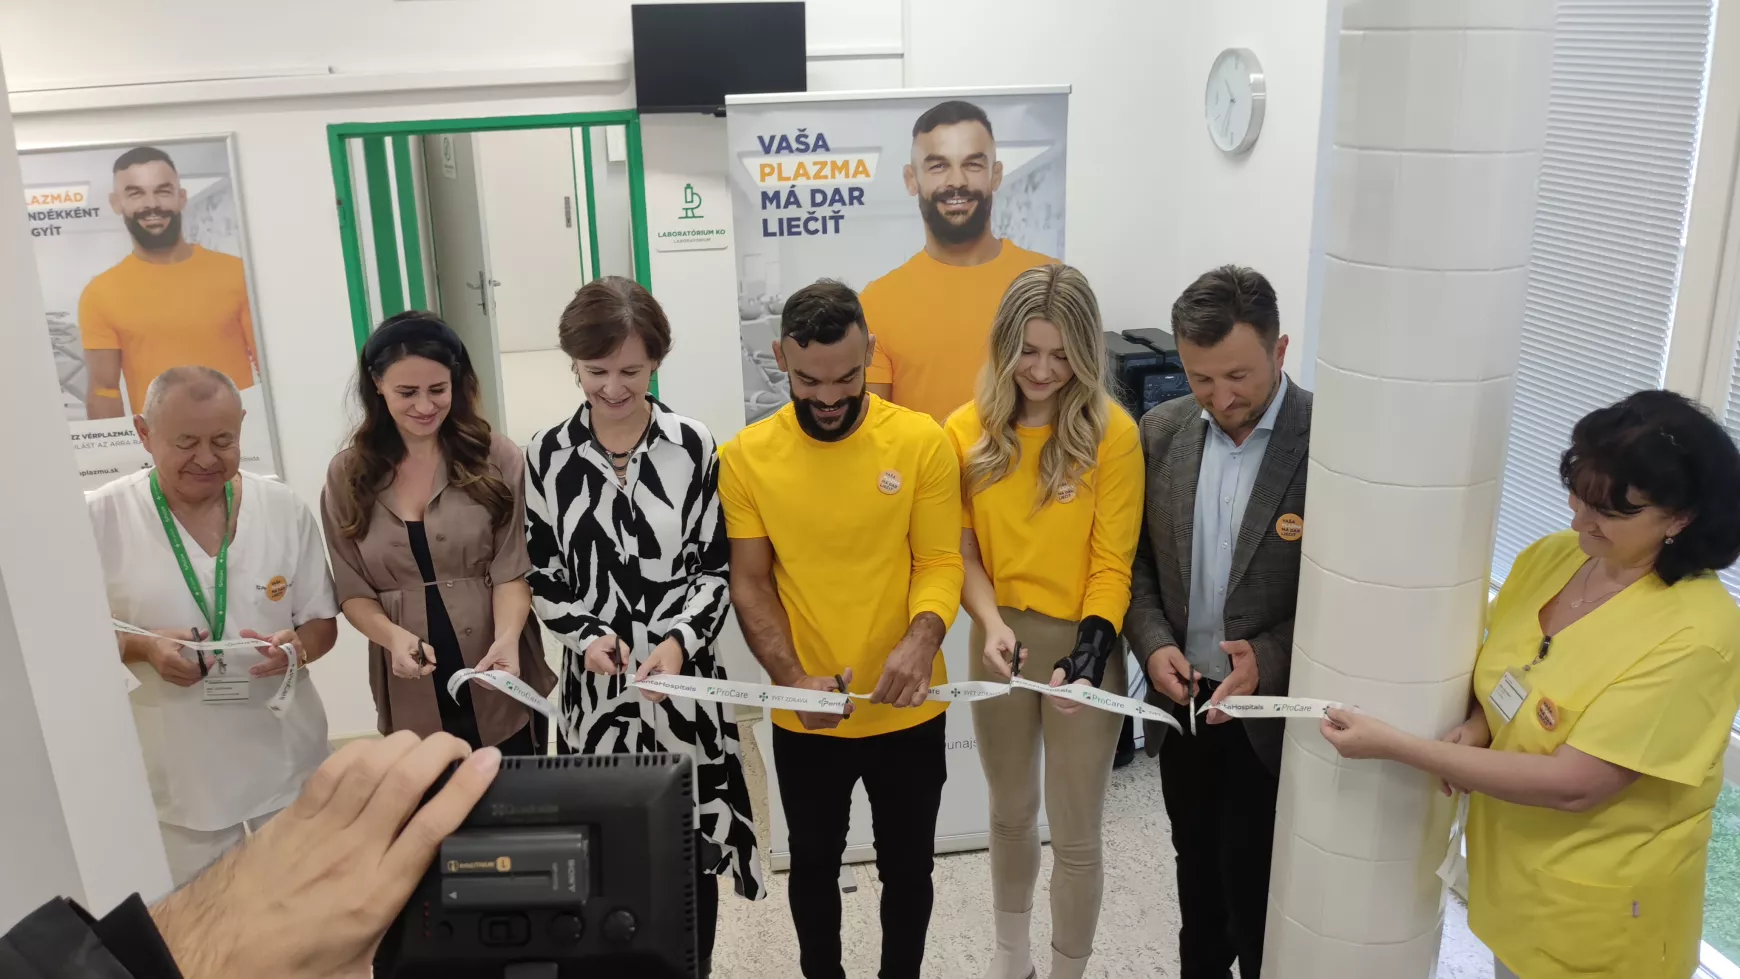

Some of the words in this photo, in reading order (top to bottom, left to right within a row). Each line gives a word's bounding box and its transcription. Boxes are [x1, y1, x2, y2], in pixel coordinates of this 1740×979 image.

[757, 128, 830, 154] VAŠA
[759, 159, 871, 182] PLAZMA
[26, 191, 83, 205] AZMÁD
[761, 184, 802, 210] MÁ
[810, 187, 865, 208] DAR
[762, 210, 844, 237] LIEČIŤ
[31, 225, 61, 237] GYÍT
[657, 229, 714, 238] LABORATÓRIUM
[82, 430, 136, 440] VÉRPLAZMÁT,
[716, 687, 749, 699] ProCare
[1092, 694, 1125, 709] ProCare
[1282, 703, 1313, 713] ProCare
